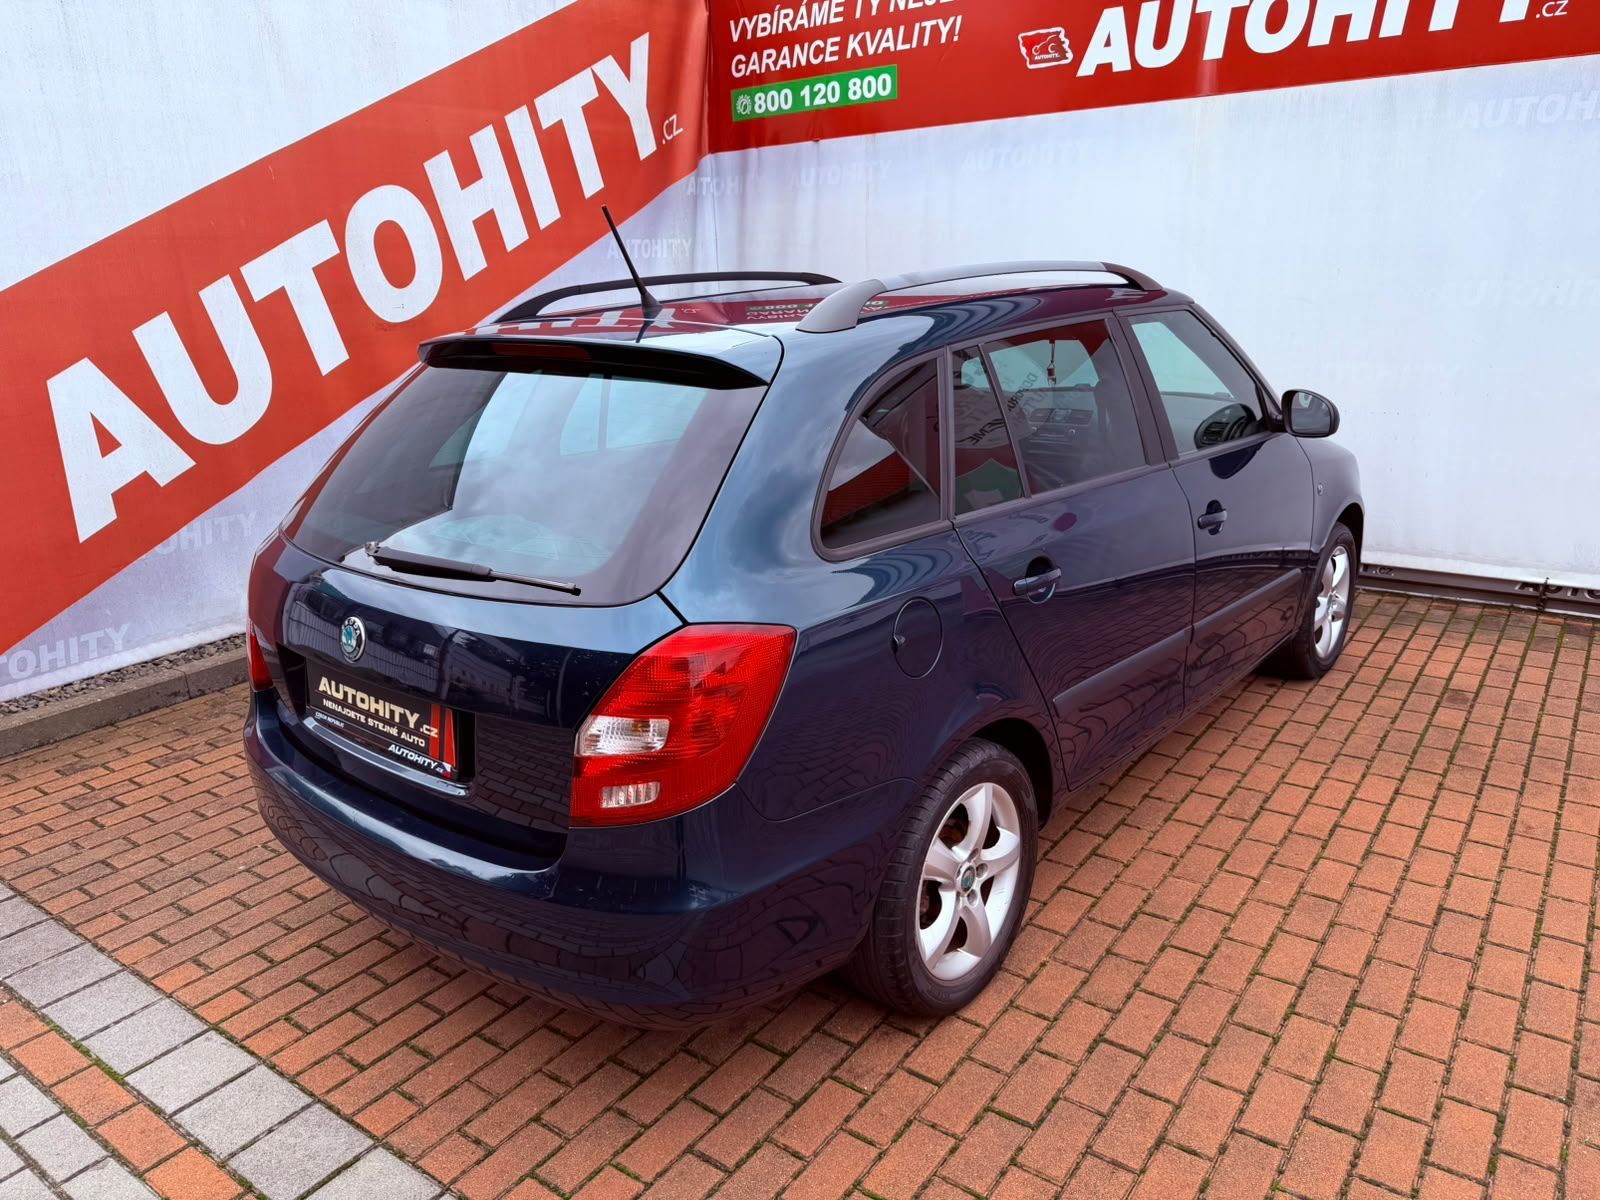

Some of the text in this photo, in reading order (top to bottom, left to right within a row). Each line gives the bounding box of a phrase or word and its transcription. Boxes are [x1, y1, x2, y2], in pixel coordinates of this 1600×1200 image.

[731, 15, 963, 79] GARANCE KVALITY!
[754, 73, 892, 114] 800 120 800
[323, 698, 426, 748] NENAJDETE STEJNÉ AUTO
